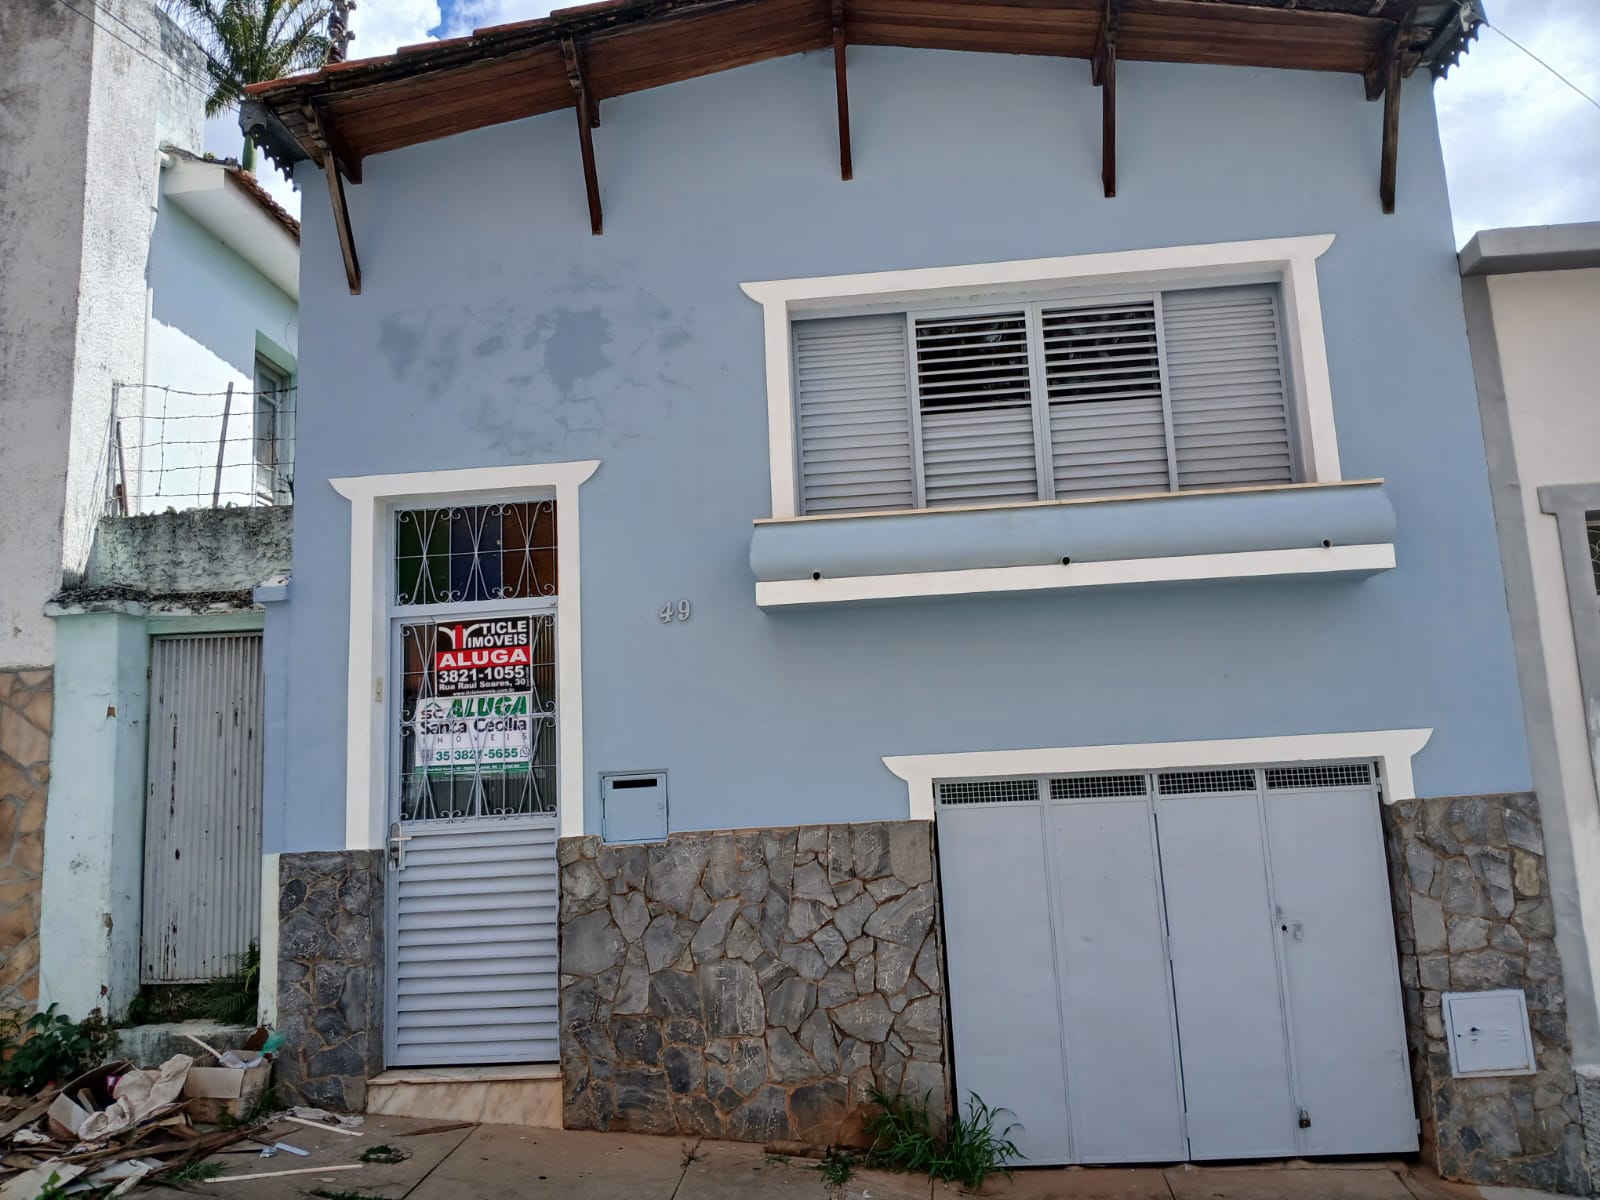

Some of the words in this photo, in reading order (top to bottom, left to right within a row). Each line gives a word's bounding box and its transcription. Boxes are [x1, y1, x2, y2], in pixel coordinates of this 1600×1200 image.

[659, 599, 691, 623] 49
[480, 620, 528, 635] TICLE
[467, 633, 528, 649] IMÓVEIS
[439, 648, 528, 668] ALUGA
[439, 665, 525, 684] 3821-1055
[439, 683, 456, 692] Rua
[457, 682, 478, 690] Raul
[479, 680, 513, 689] Soares,
[514, 678, 526, 686] 30
[446, 696, 527, 718] ALUGA
[435, 750, 451, 761] 35
